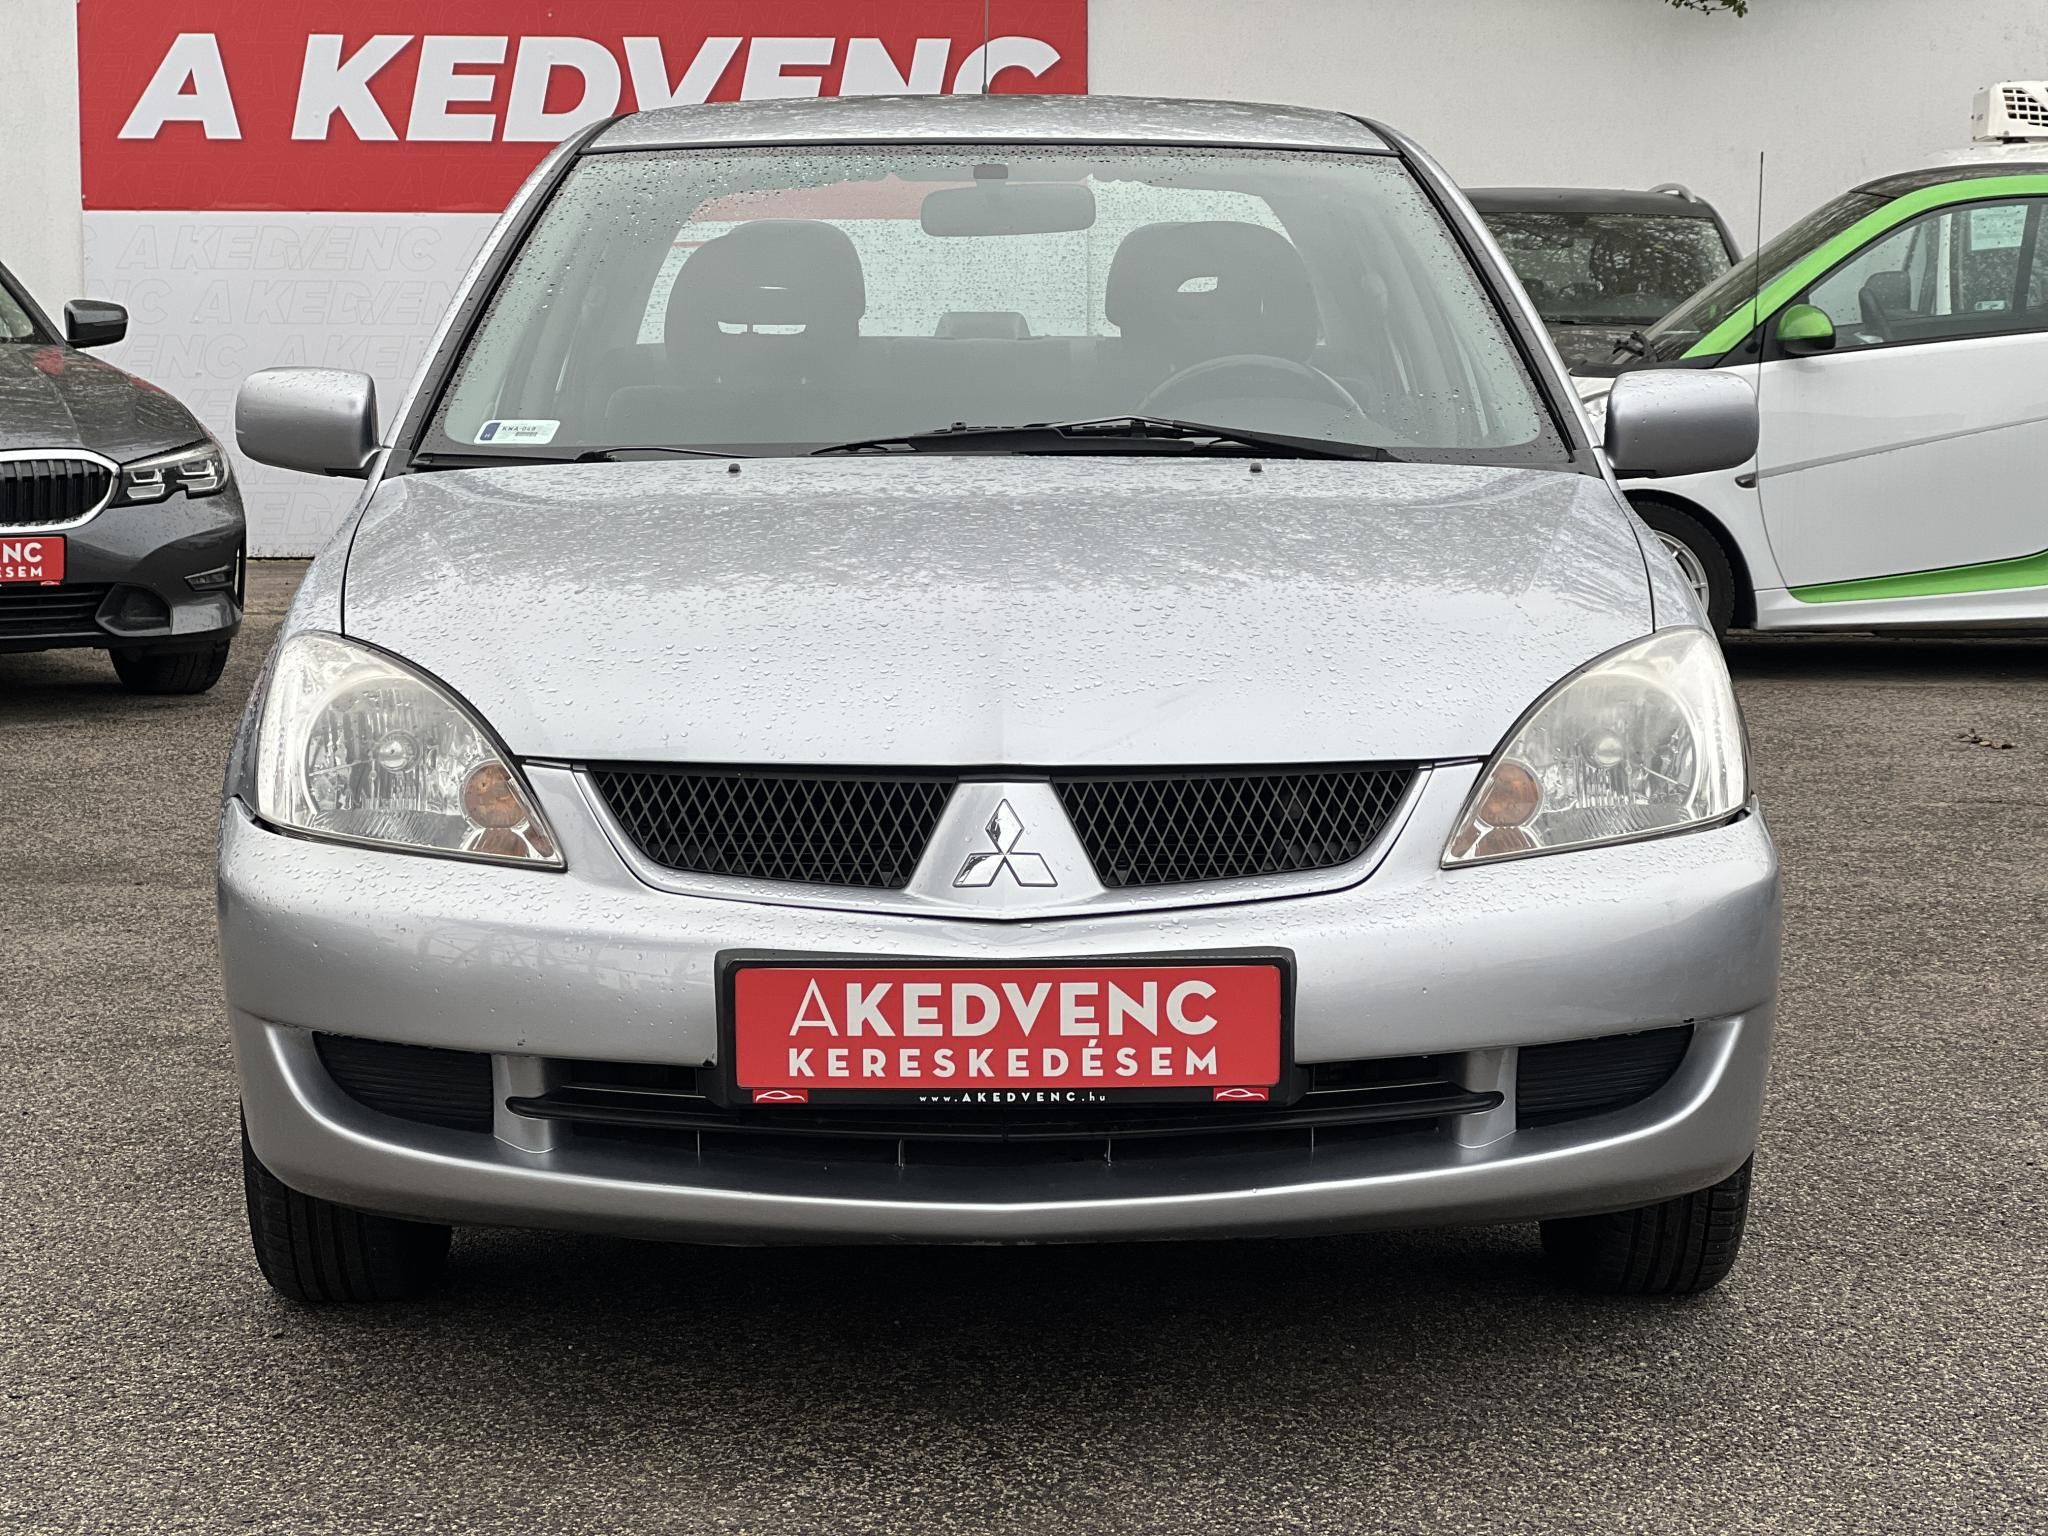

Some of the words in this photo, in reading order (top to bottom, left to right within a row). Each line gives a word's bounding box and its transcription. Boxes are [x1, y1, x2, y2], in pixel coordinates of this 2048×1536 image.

[118, 33, 242, 140] A
[291, 34, 1062, 142] KEDVENC
[0, 566, 43, 578] SEM
[789, 976, 1218, 1038] AKEDVENC
[788, 1039, 1219, 1078] KERESKEDÉSEM
[919, 1091, 1106, 1103] www.AKEDVENC.hu
